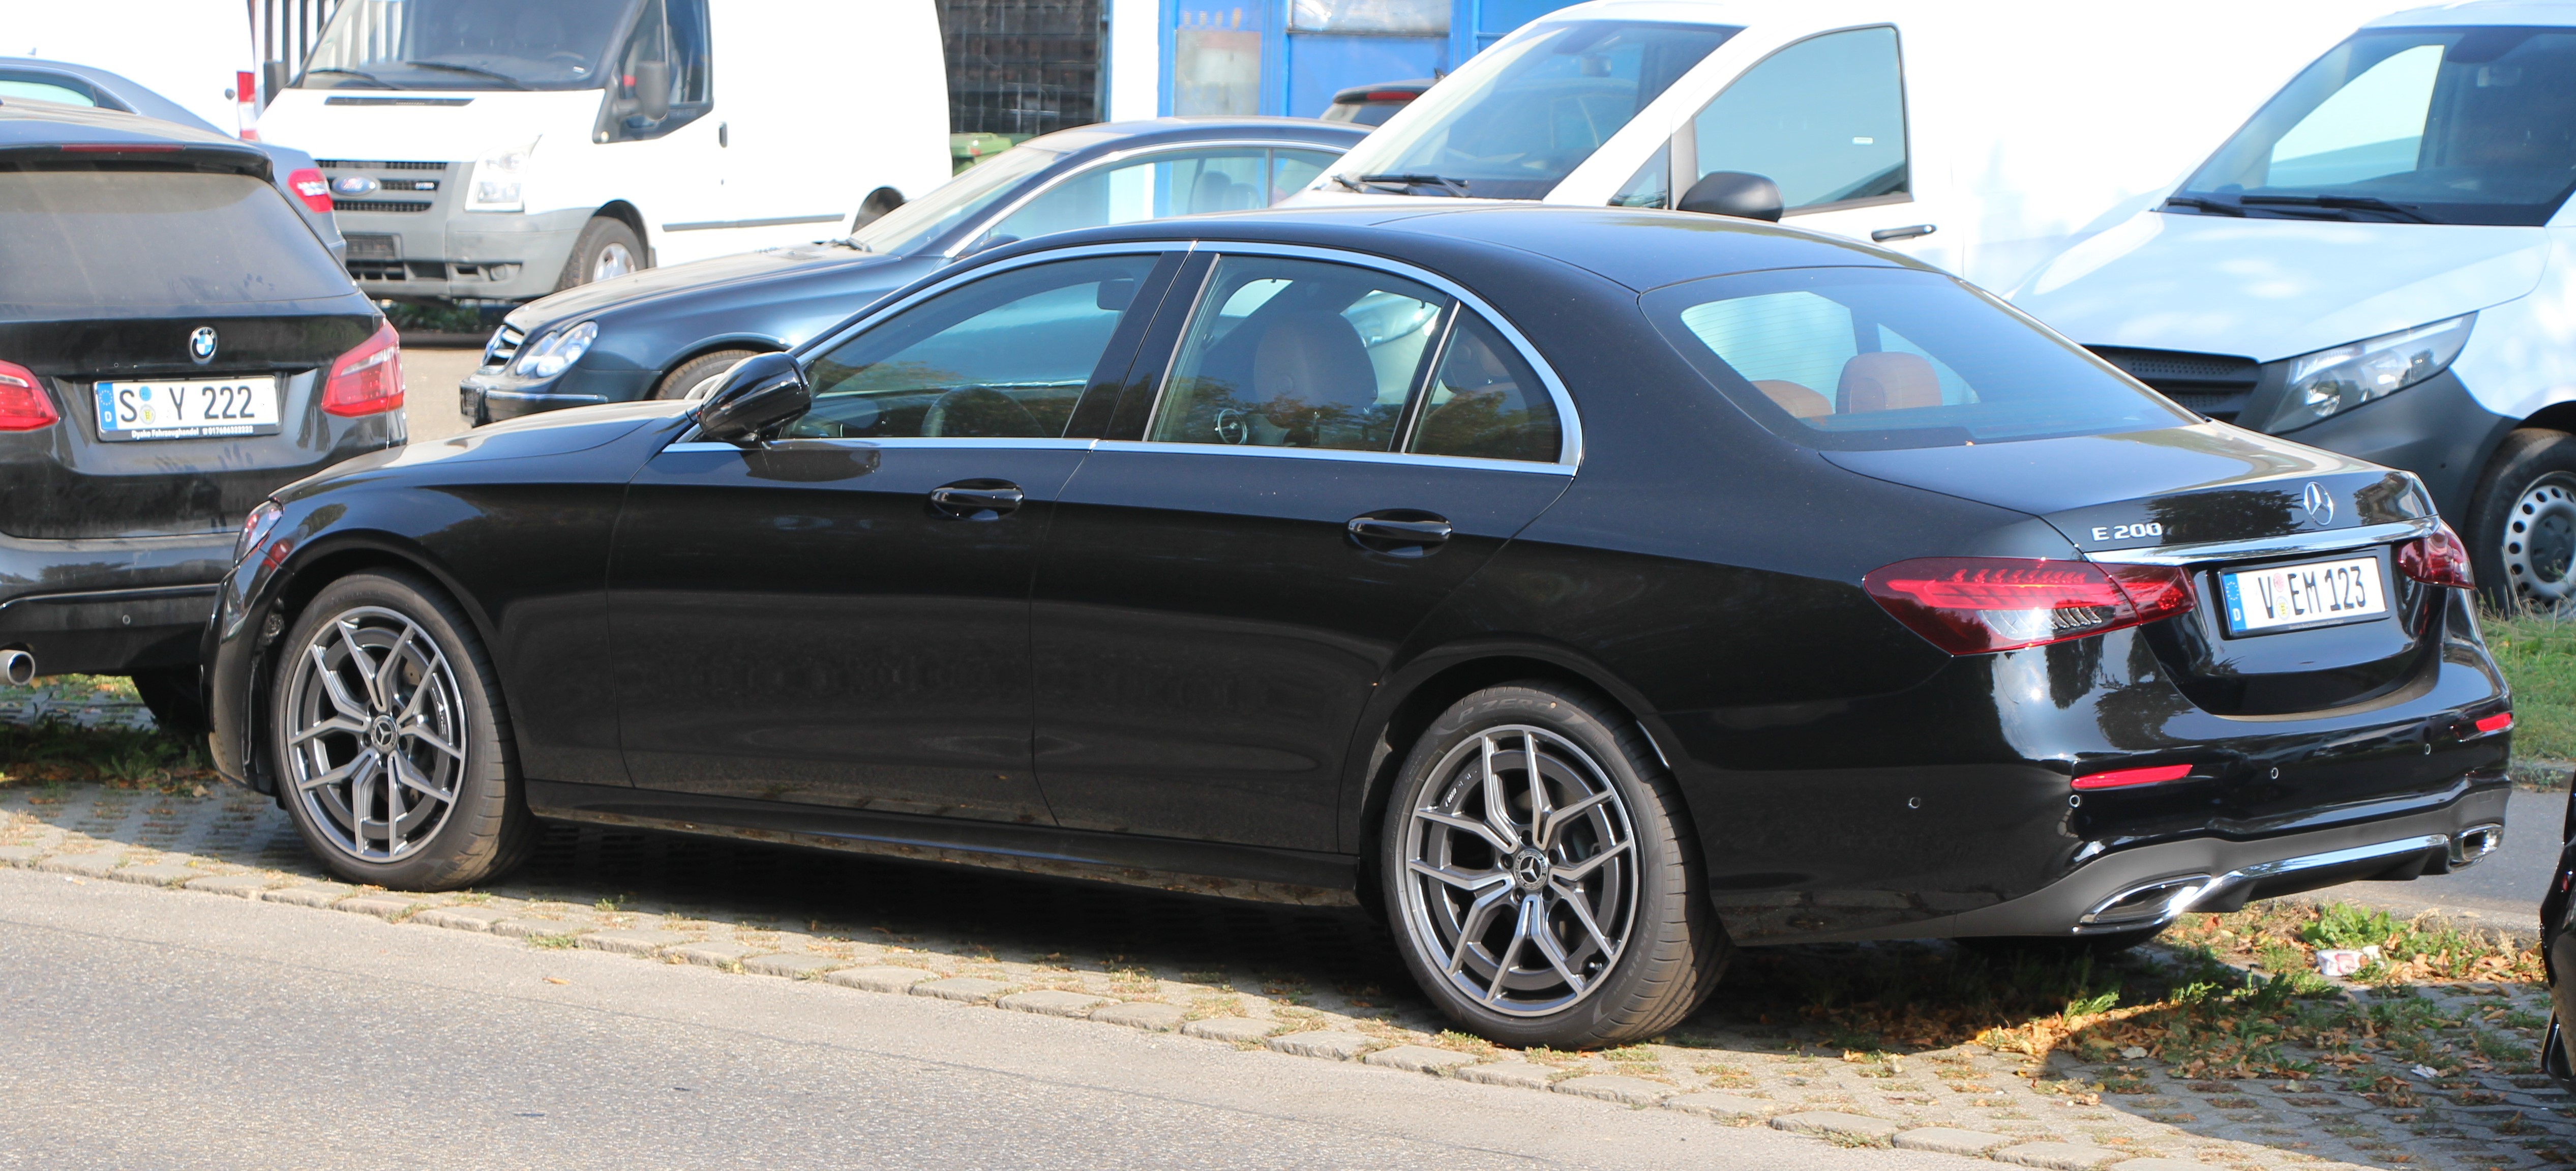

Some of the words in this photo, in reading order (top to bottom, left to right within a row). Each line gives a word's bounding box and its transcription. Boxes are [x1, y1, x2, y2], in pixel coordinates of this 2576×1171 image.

[119, 389, 137, 423] S
[169, 387, 185, 420] Y
[202, 386, 255, 420] 222
[104, 411, 112, 422] D
[2091, 527, 2110, 541] E
[2113, 522, 2163, 540] 200
[2258, 576, 2274, 619] V
[2287, 571, 2321, 616] EM
[2324, 566, 2366, 611] 123
[2233, 608, 2241, 621] D
[1458, 706, 1474, 723] P
